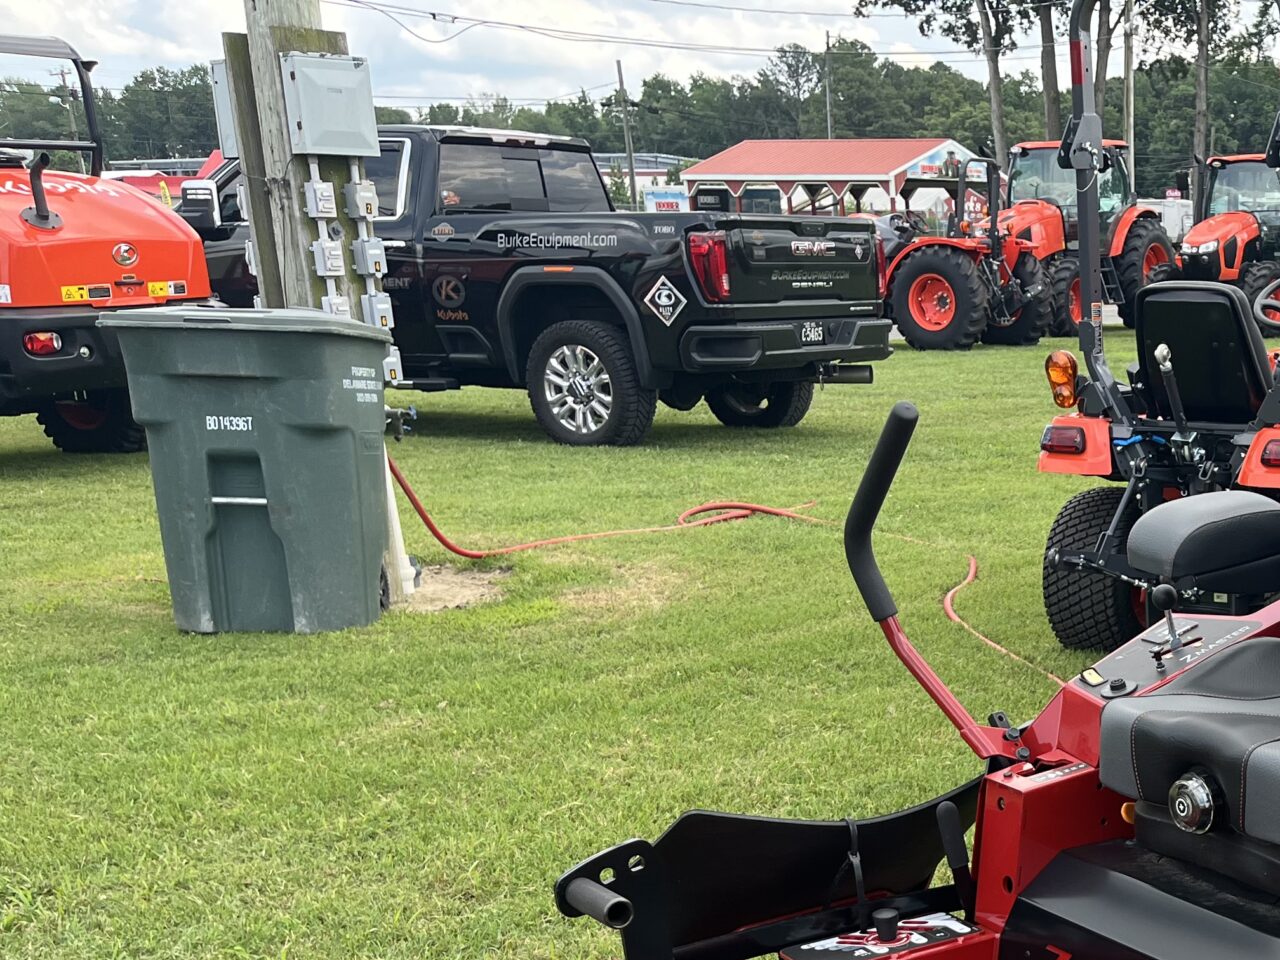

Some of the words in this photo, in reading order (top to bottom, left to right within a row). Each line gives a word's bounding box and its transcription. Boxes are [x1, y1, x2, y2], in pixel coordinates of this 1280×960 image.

[653, 225, 675, 235] TORO
[497, 232, 618, 250] BurkeEquipment.com
[791, 241, 836, 257] GMC
[792, 281, 834, 289] DENALI
